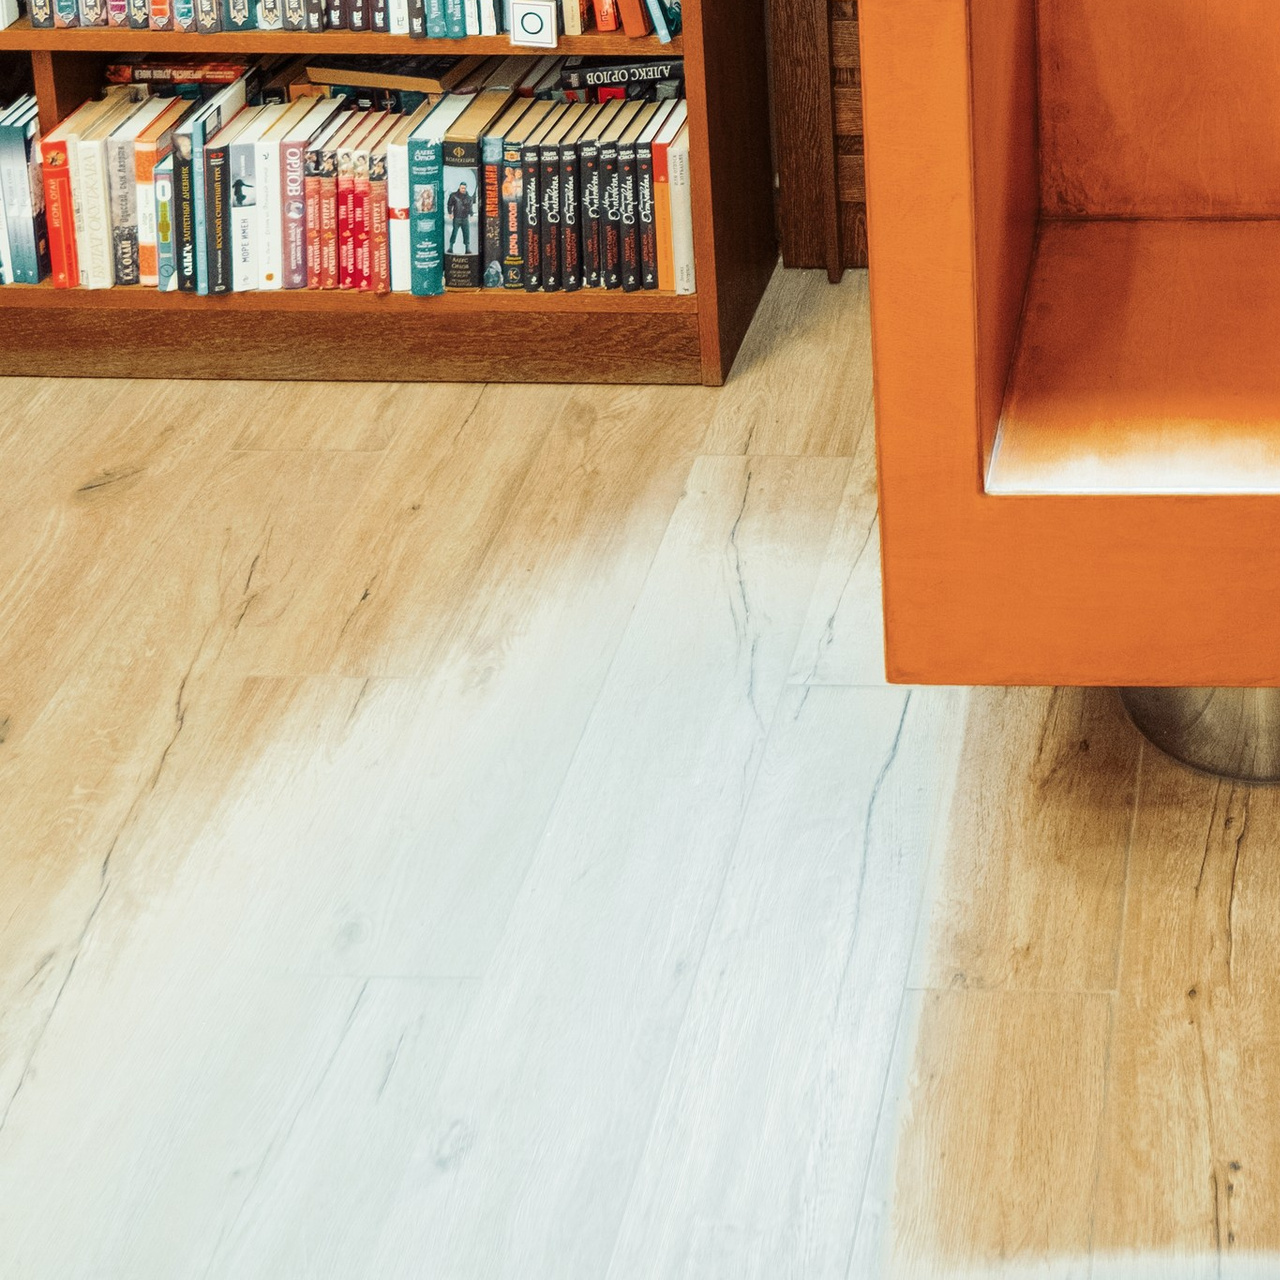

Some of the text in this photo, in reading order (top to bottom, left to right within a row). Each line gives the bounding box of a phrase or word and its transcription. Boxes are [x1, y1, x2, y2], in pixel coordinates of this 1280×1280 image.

[586, 66, 670, 84] АЛЕКС ОРЛОВ
[286, 148, 300, 196] ОРЛОВ
[51, 202, 60, 227] ИГОРЬ
[181, 201, 191, 242] ЗАПРЕТНЫЙ
[322, 198, 330, 230] СУПРУГ
[372, 202, 380, 233] СУПРУГ
[508, 202, 518, 256] ДОЧЬ КОРОЛЯ
